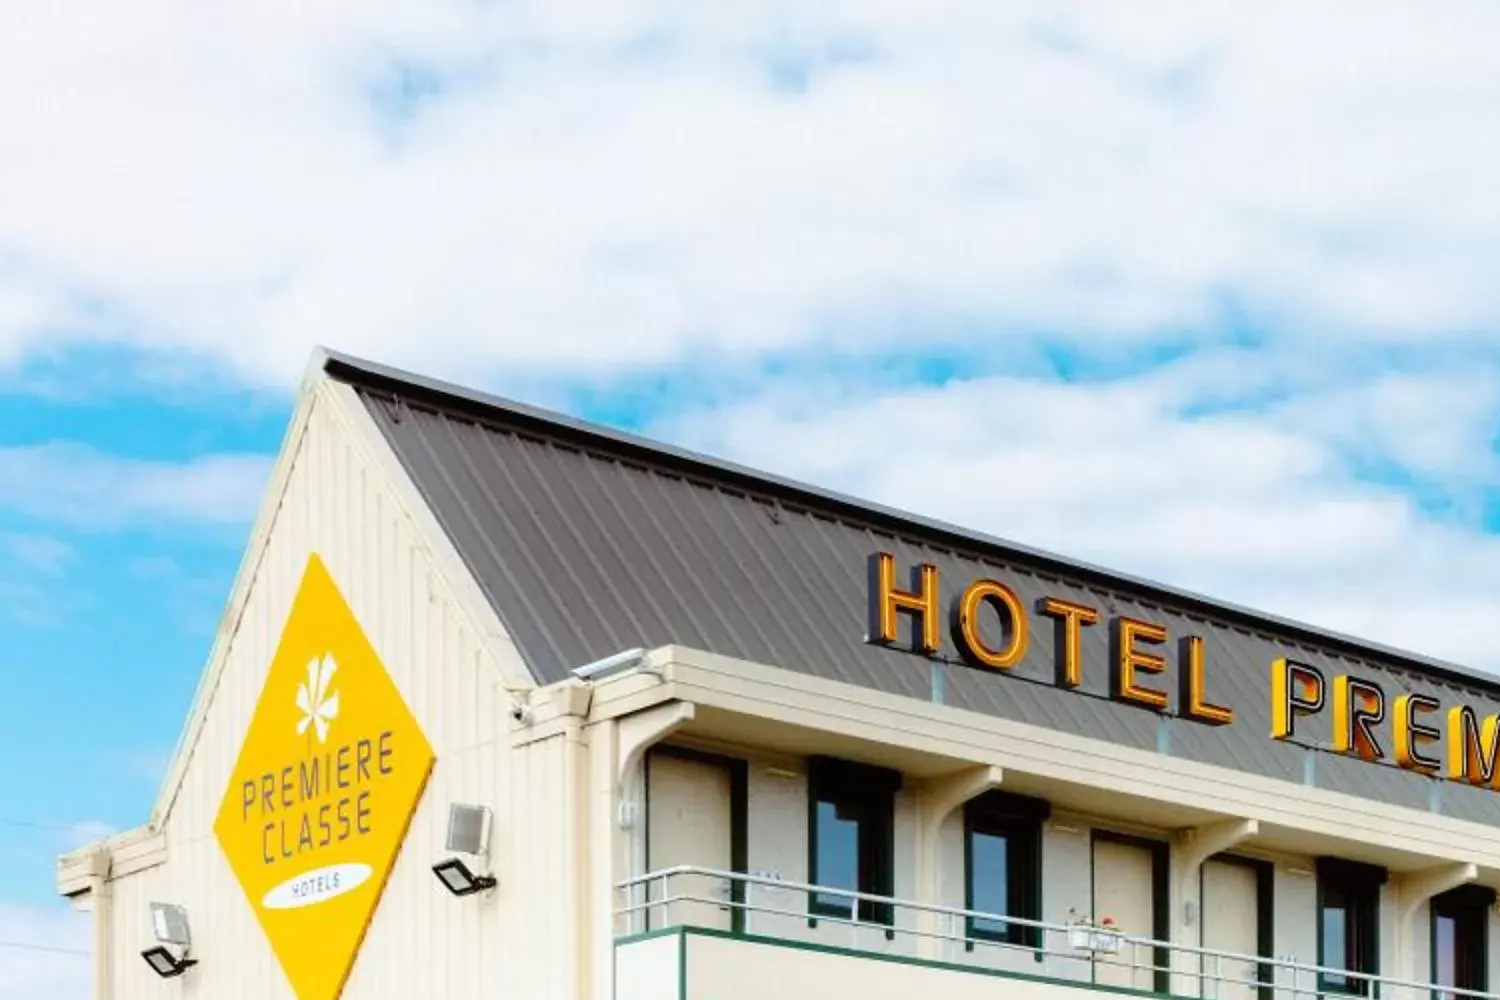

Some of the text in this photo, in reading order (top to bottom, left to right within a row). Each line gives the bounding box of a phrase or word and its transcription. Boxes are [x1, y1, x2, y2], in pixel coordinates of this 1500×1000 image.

[868, 552, 1232, 725] HOTEL
[242, 730, 393, 822] PREMIERE
[263, 791, 371, 864] CLASSE
[291, 872, 340, 898] HOTELS
